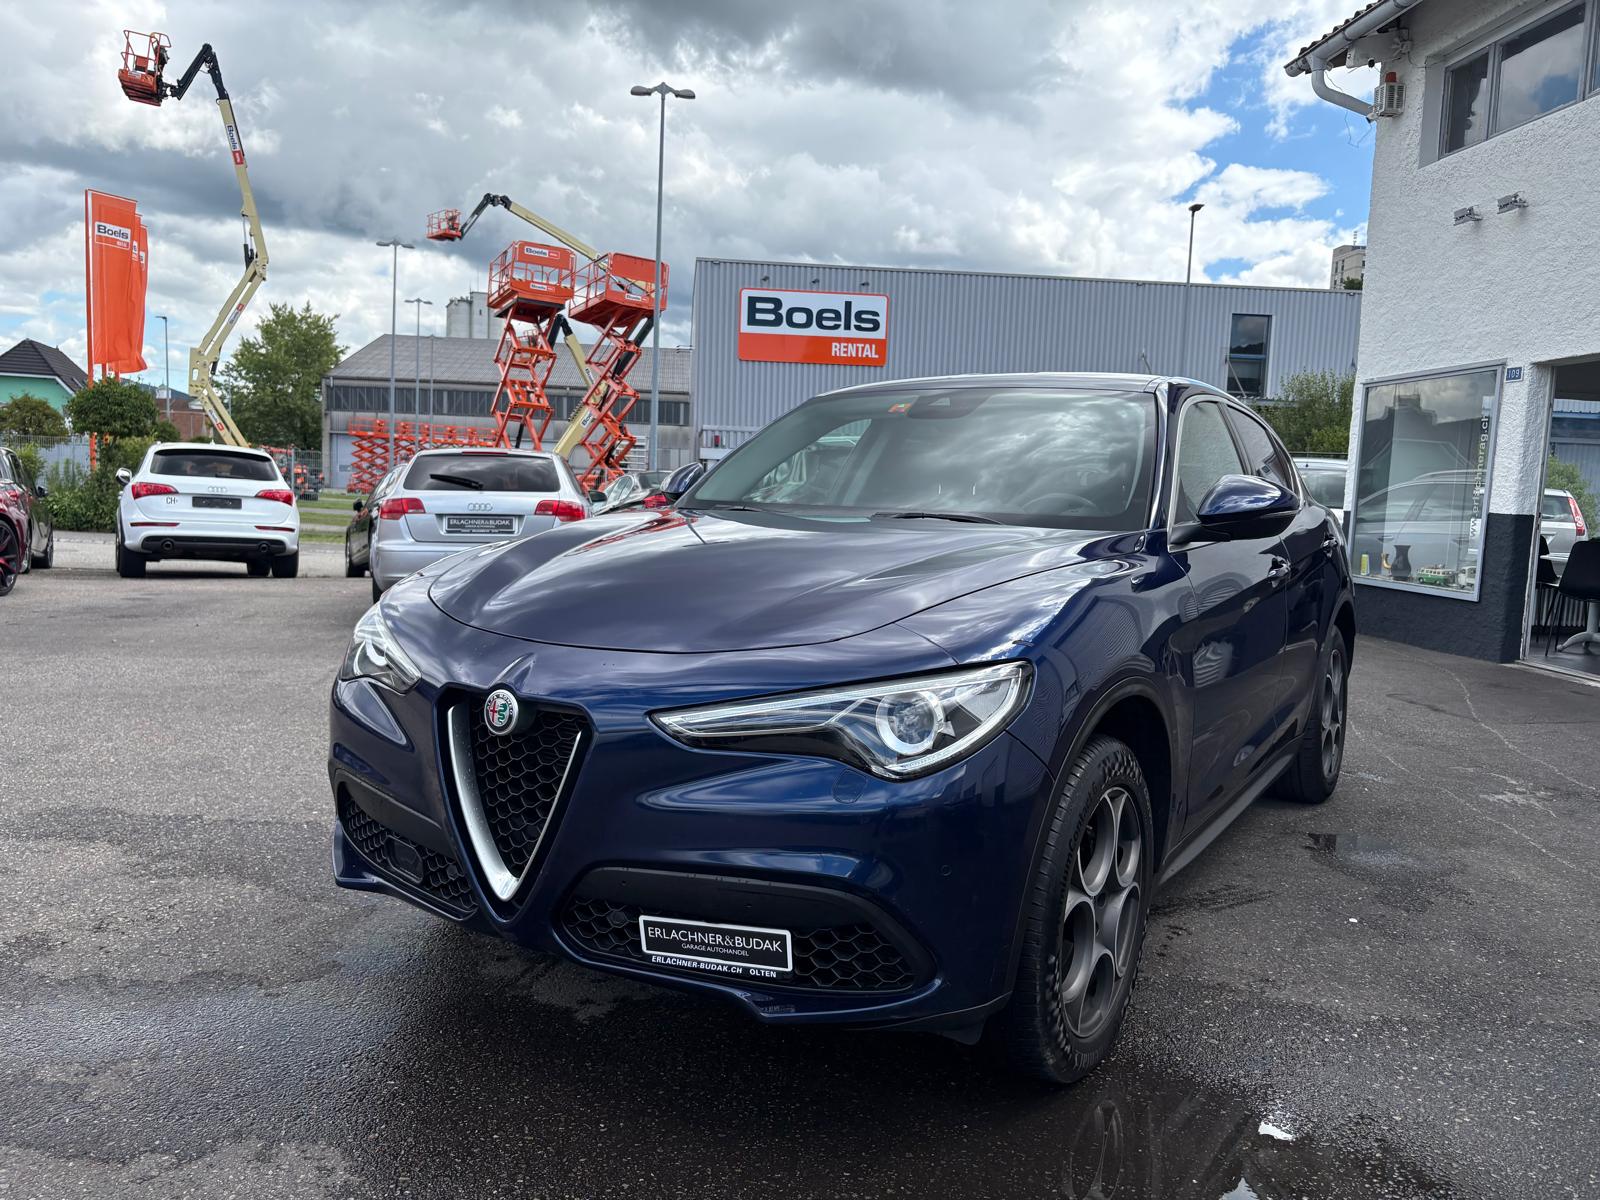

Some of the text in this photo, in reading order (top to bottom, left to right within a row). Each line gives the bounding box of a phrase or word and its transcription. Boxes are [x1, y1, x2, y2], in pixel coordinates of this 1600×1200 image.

[226, 125, 238, 150] Boels
[96, 224, 129, 240] Boels
[746, 296, 881, 333] Boels
[831, 342, 879, 358] RENTAL
[1508, 368, 1520, 379] 109
[165, 496, 176, 504] CH
[647, 926, 783, 953] ERLACHNER&BUDAK
[681, 942, 750, 957] GARAGE AUTOHANDEL
[651, 955, 777, 978] ERLACHNER-BUDAK.CH OLTEN
